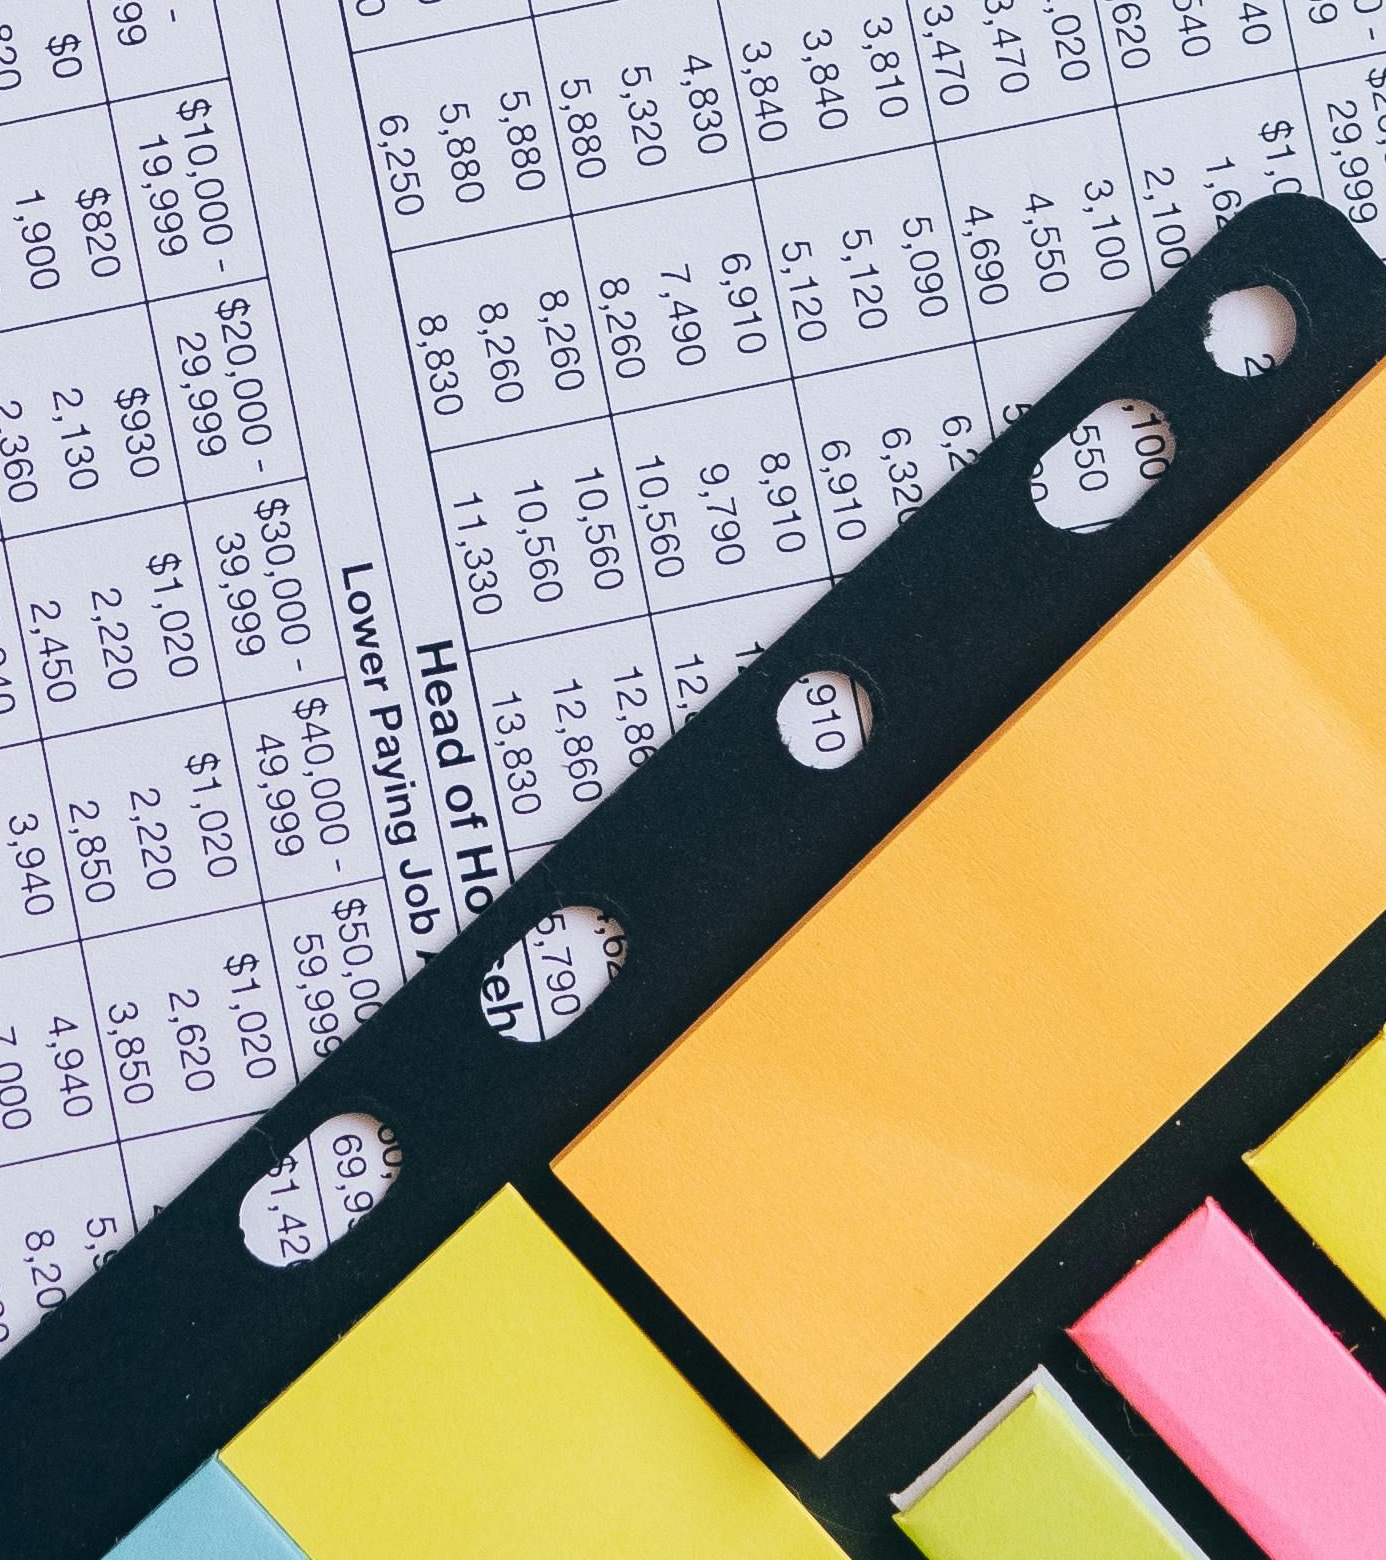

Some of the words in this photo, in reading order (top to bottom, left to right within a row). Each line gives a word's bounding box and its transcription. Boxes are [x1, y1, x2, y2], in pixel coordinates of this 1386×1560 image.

[74, 186, 122, 279] $820
[452, 491, 504, 616] 11,330
[340, 561, 390, 693] Lower
[368, 703, 419, 847] Paying
[398, 857, 441, 936] Job
[415, 639, 477, 769] Head
[444, 783, 490, 831] of
